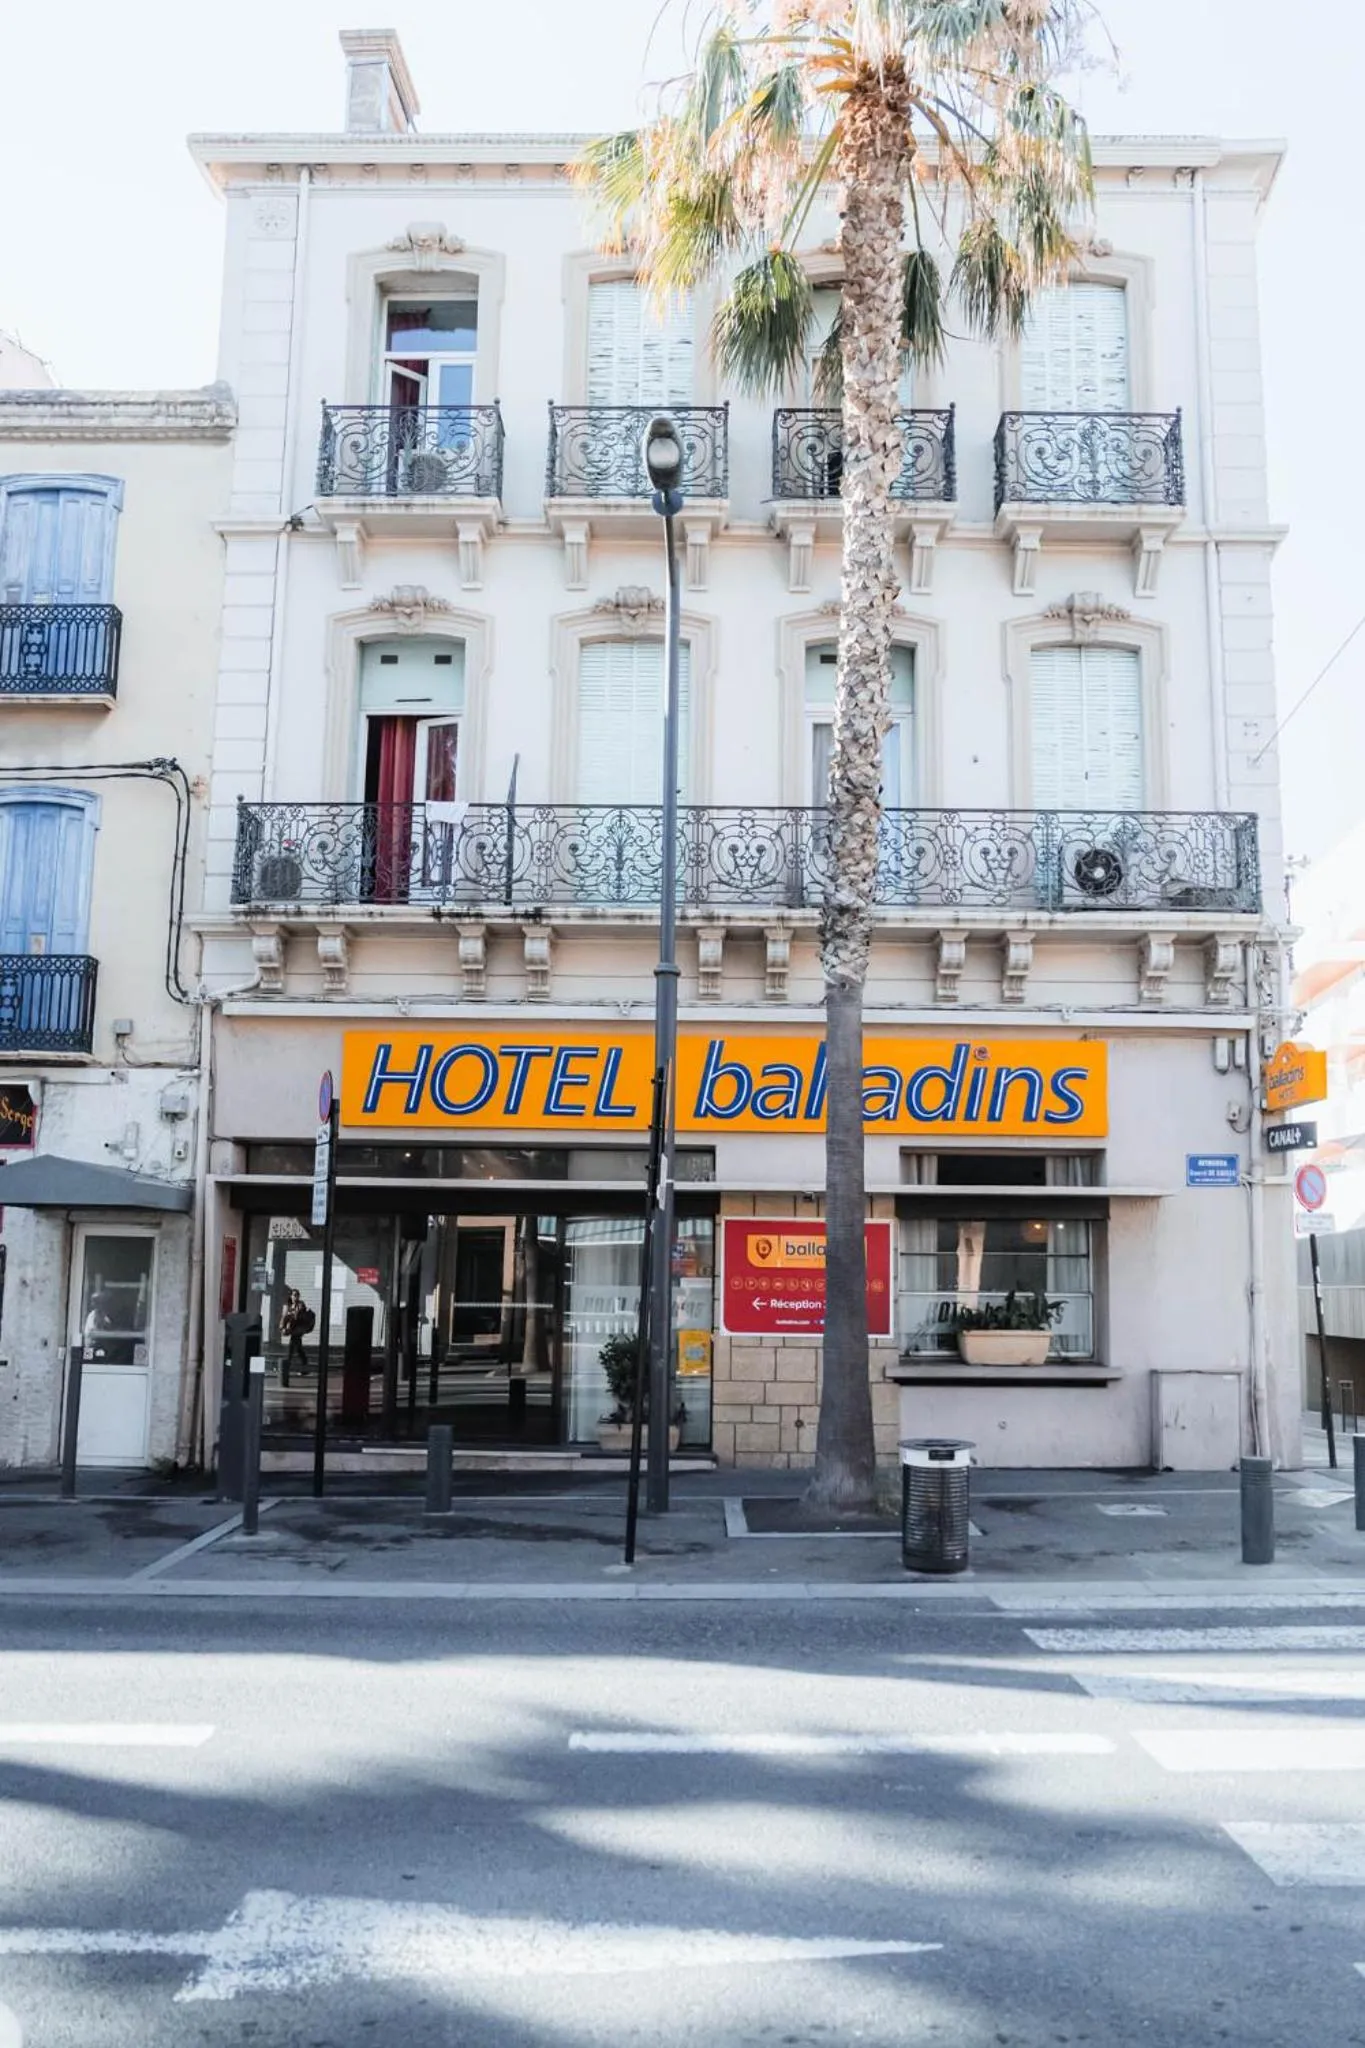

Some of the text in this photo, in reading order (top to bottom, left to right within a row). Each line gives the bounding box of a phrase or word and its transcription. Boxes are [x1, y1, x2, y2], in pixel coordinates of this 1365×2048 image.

[361, 1039, 1089, 1124] HOTEL baladins
[1268, 1126, 1302, 1148] CANAL+
[785, 1241, 827, 1256] balla
[770, 1298, 823, 1311] Réception
